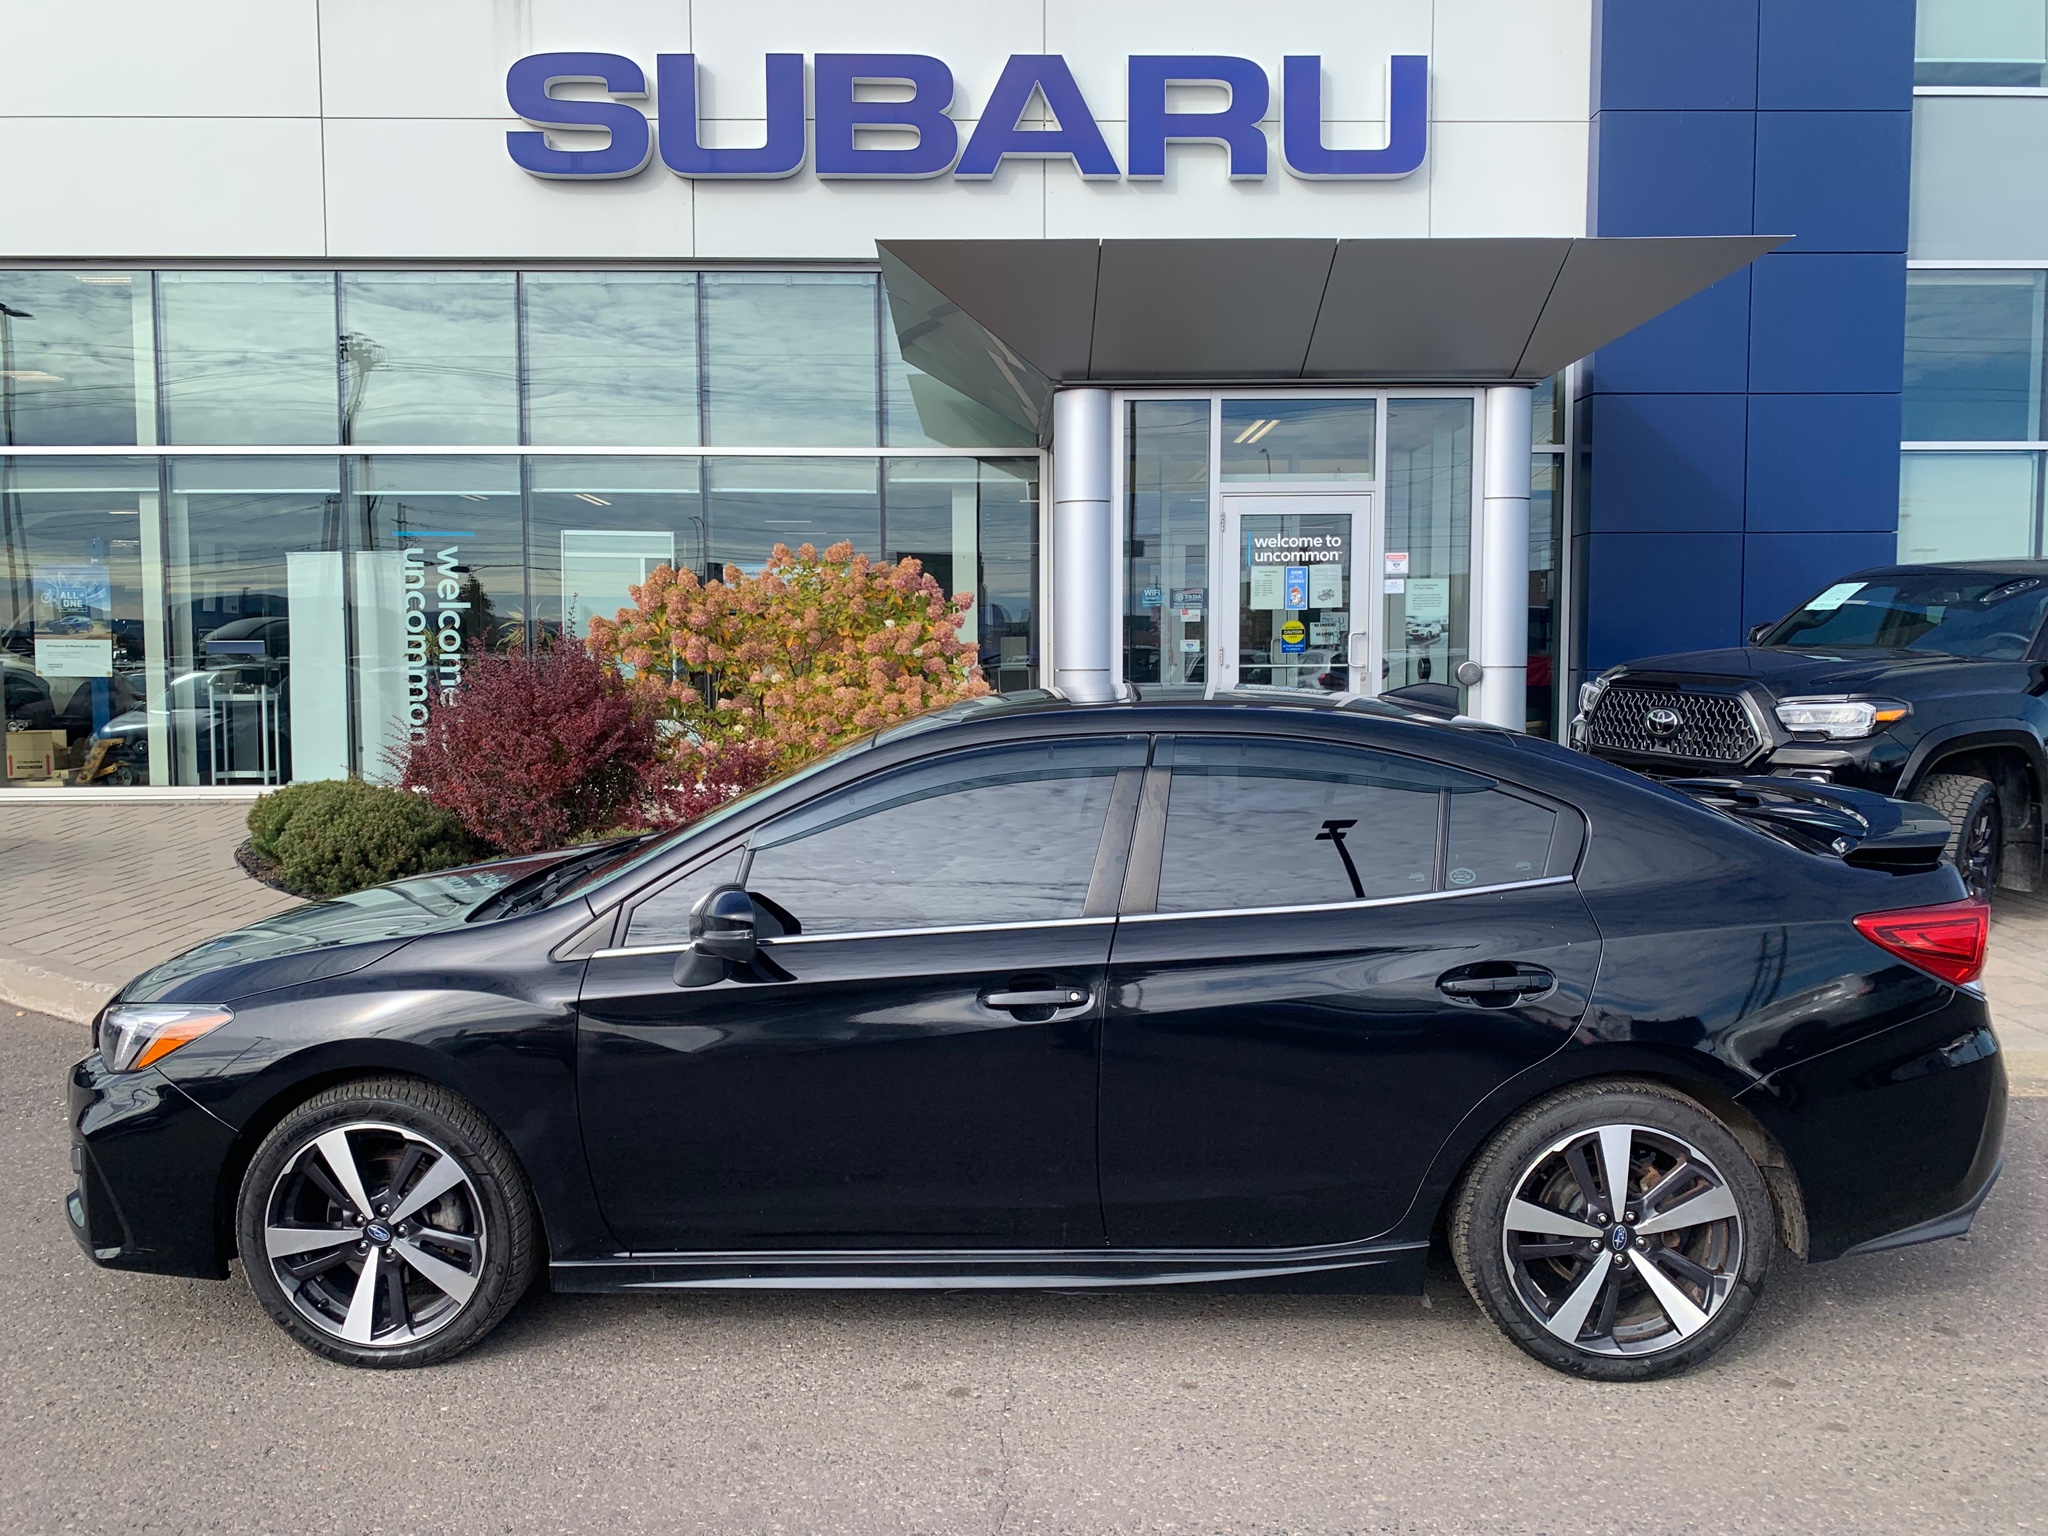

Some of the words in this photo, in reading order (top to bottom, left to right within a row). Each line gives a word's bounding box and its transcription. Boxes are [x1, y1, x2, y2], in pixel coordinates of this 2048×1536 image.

[506, 51, 1430, 182] SUBARU
[1254, 533, 1322, 548] welcome
[1325, 534, 1342, 547] to
[60, 591, 79, 600] ALL
[63, 599, 83, 608] ONE
[436, 545, 472, 708] welcome
